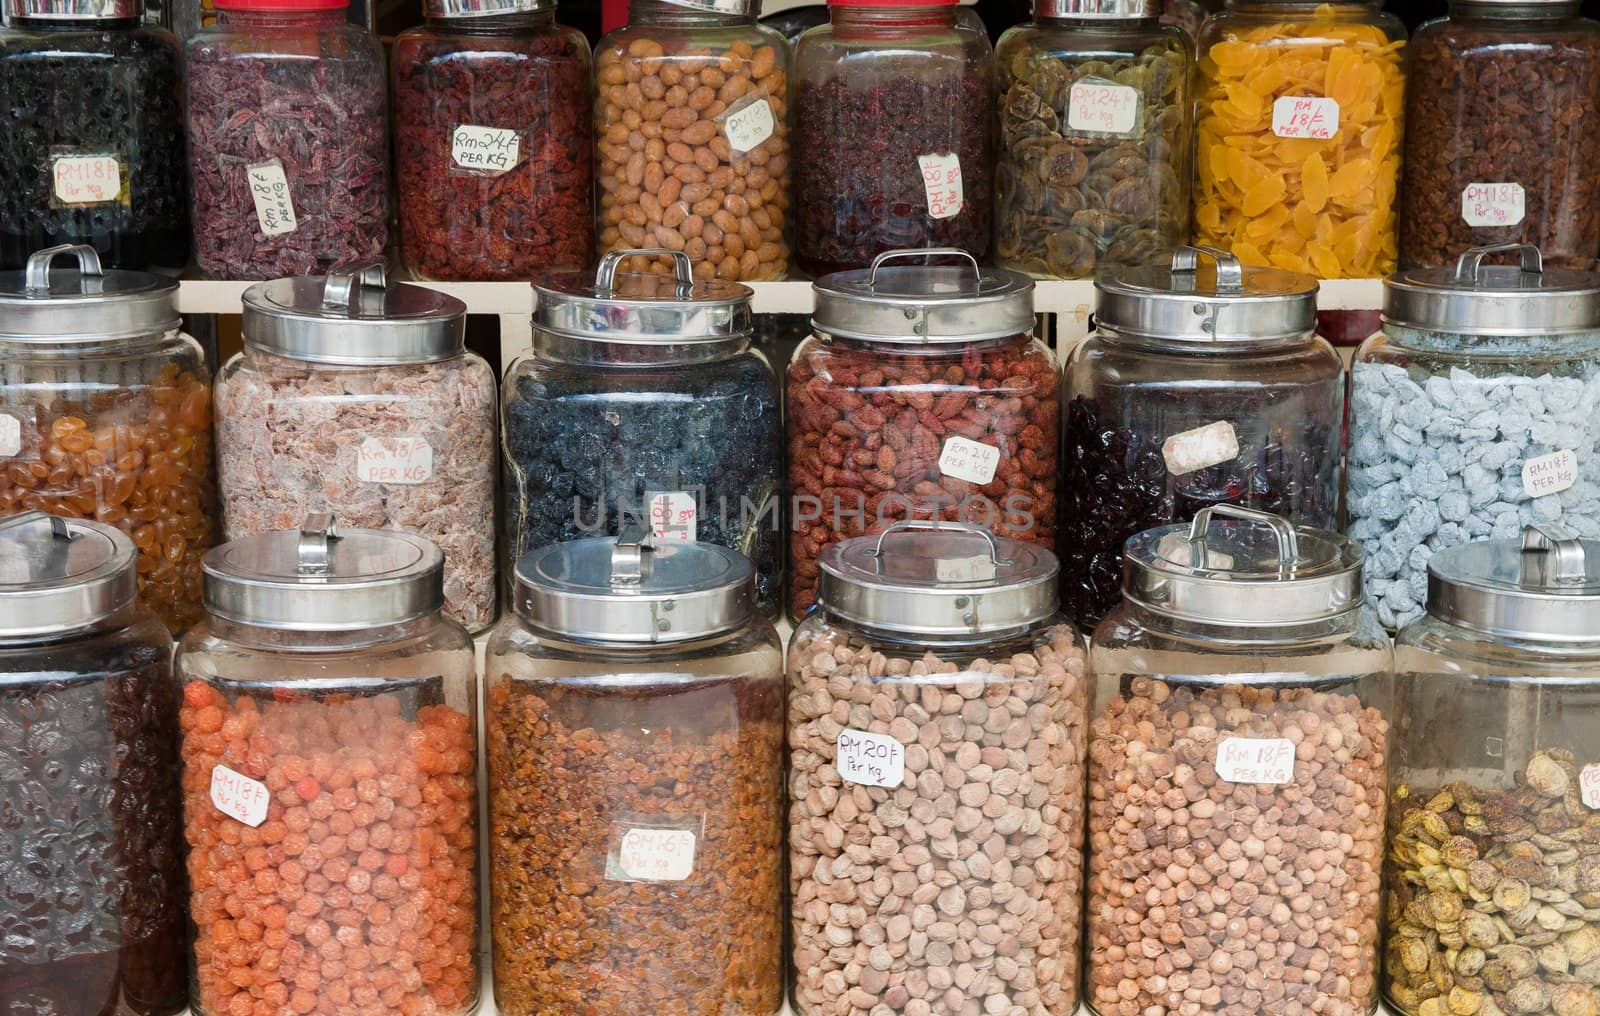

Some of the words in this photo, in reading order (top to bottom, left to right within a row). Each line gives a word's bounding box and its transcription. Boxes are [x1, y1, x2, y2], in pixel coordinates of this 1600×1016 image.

[1294, 100, 1313, 111] RM
[1278, 125, 1300, 136] PER
[1312, 129, 1329, 138] KG
[460, 152, 483, 164] PER
[279, 201, 293, 223] PER
[369, 466, 396, 480] PER
[403, 465, 427, 481] KG
[944, 456, 966, 468] PER
[973, 462, 990, 477] KG
[1533, 478, 1554, 492] PER
[1557, 471, 1572, 484] KG
[848, 755, 862, 771] Per
[1232, 766, 1257, 780] PER
[1263, 768, 1286, 780] KG
